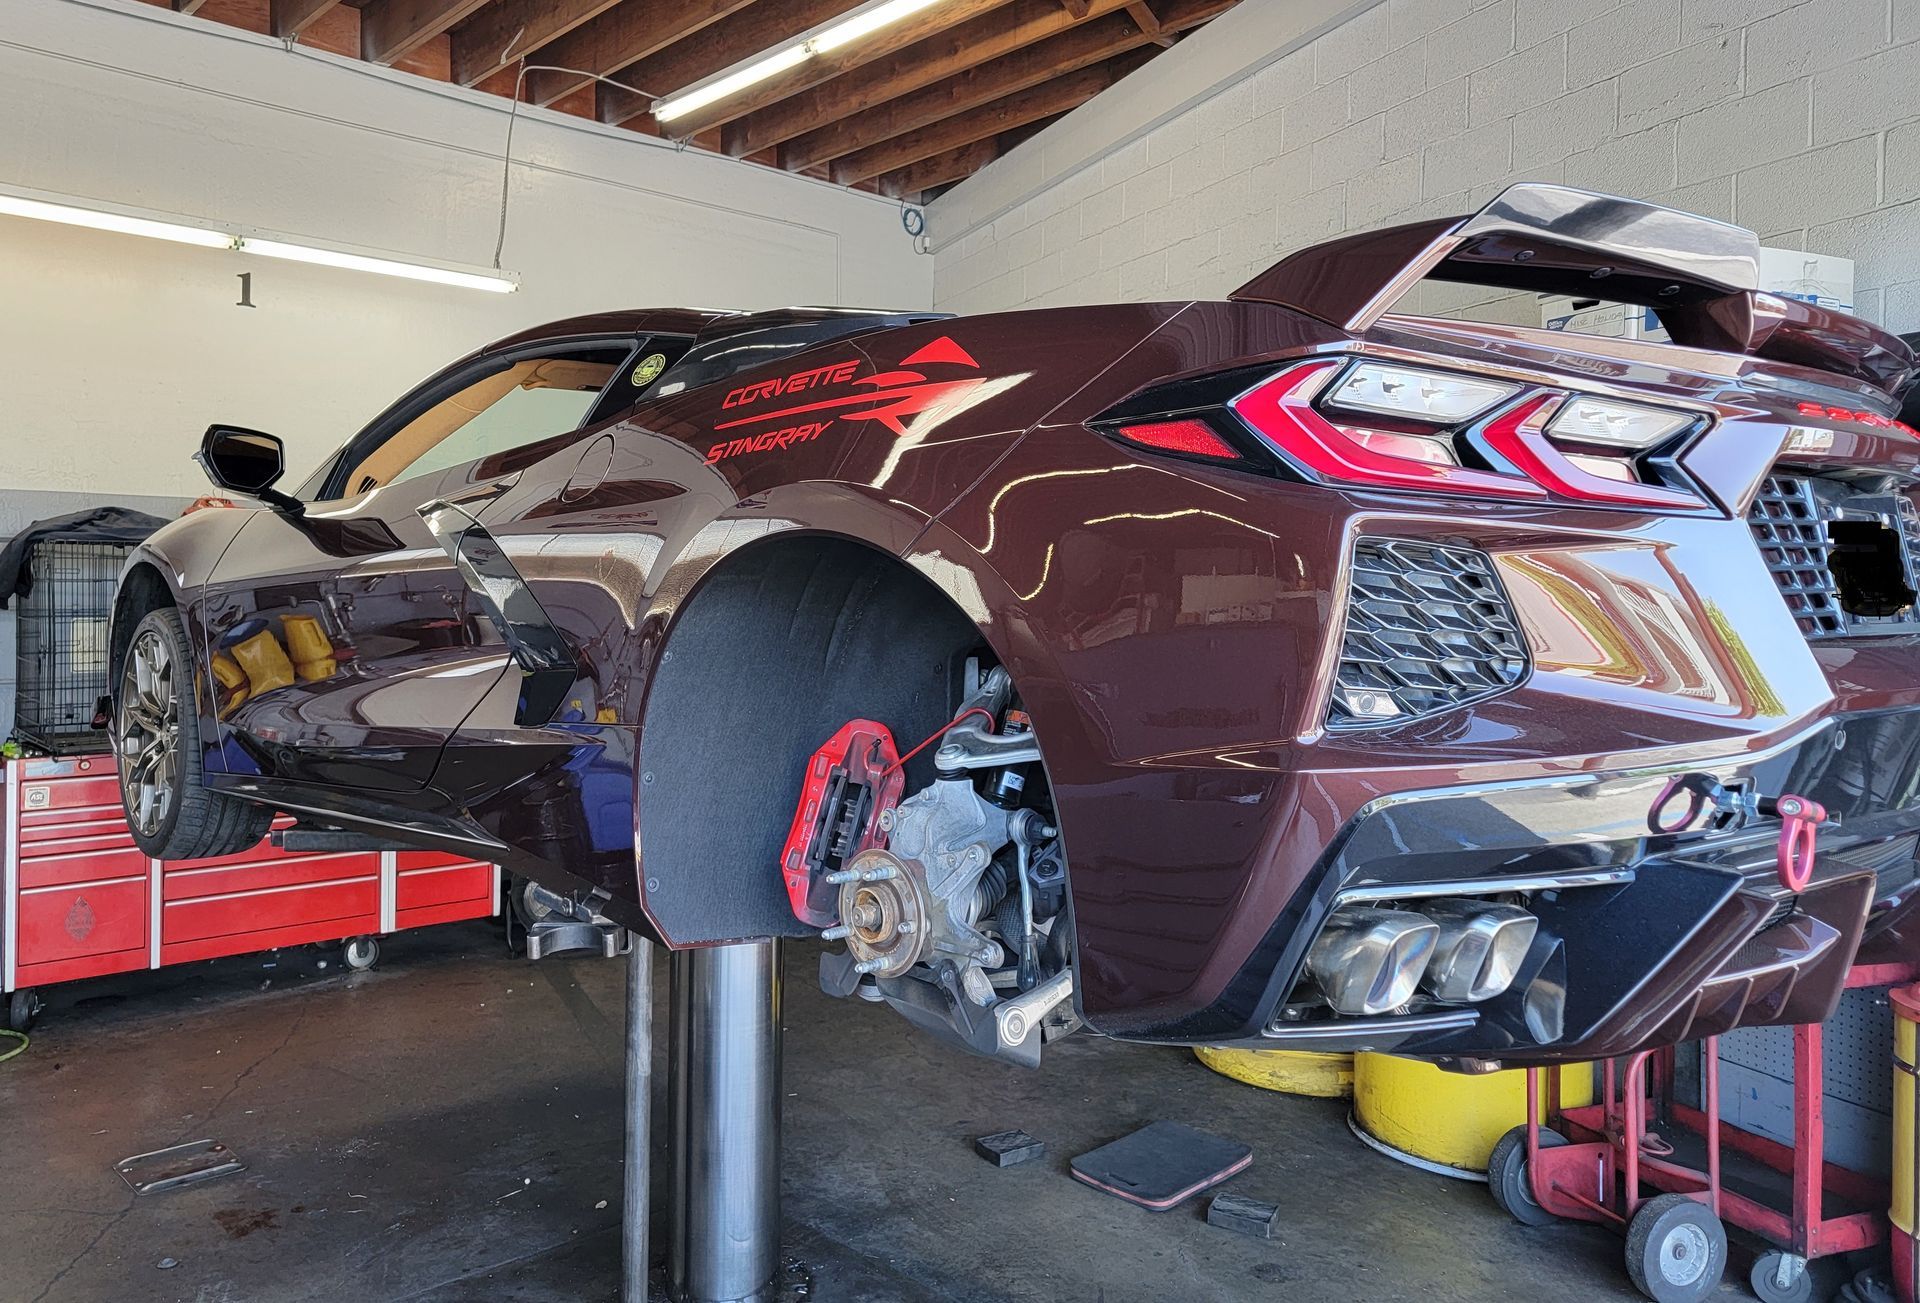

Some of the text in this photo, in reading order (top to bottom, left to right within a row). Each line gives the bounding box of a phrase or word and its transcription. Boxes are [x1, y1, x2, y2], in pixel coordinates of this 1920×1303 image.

[236, 272, 257, 309] 1
[722, 360, 860, 409] CORVETTE
[703, 420, 834, 466] STINGRAY
